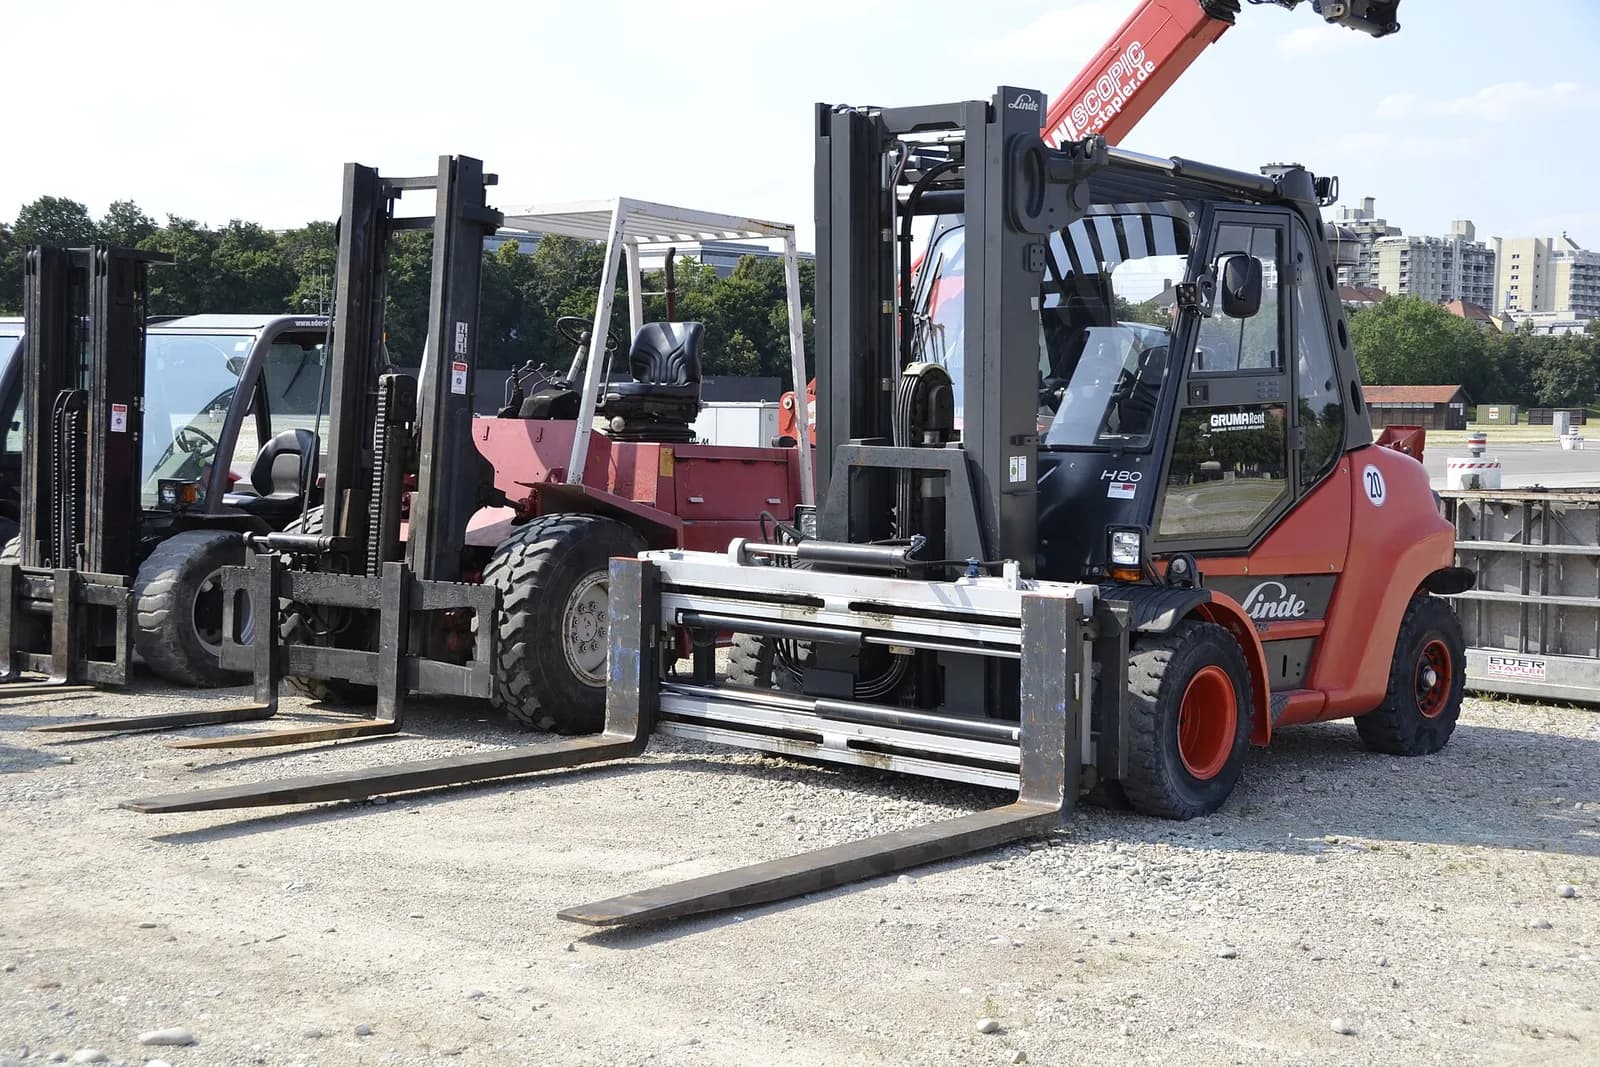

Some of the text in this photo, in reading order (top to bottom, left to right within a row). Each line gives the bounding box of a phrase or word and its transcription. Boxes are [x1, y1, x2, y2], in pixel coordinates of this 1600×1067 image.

[1008, 93, 1039, 111] Linde
[1044, 41, 1145, 149] NISCOPIC
[1211, 411, 1265, 427] GRUMA Rent
[1100, 469, 1142, 482] H80
[1366, 471, 1382, 498] 20
[1241, 581, 1305, 619] Linde
[1488, 664, 1545, 675] STAPLER
[1490, 656, 1545, 669] EDER
